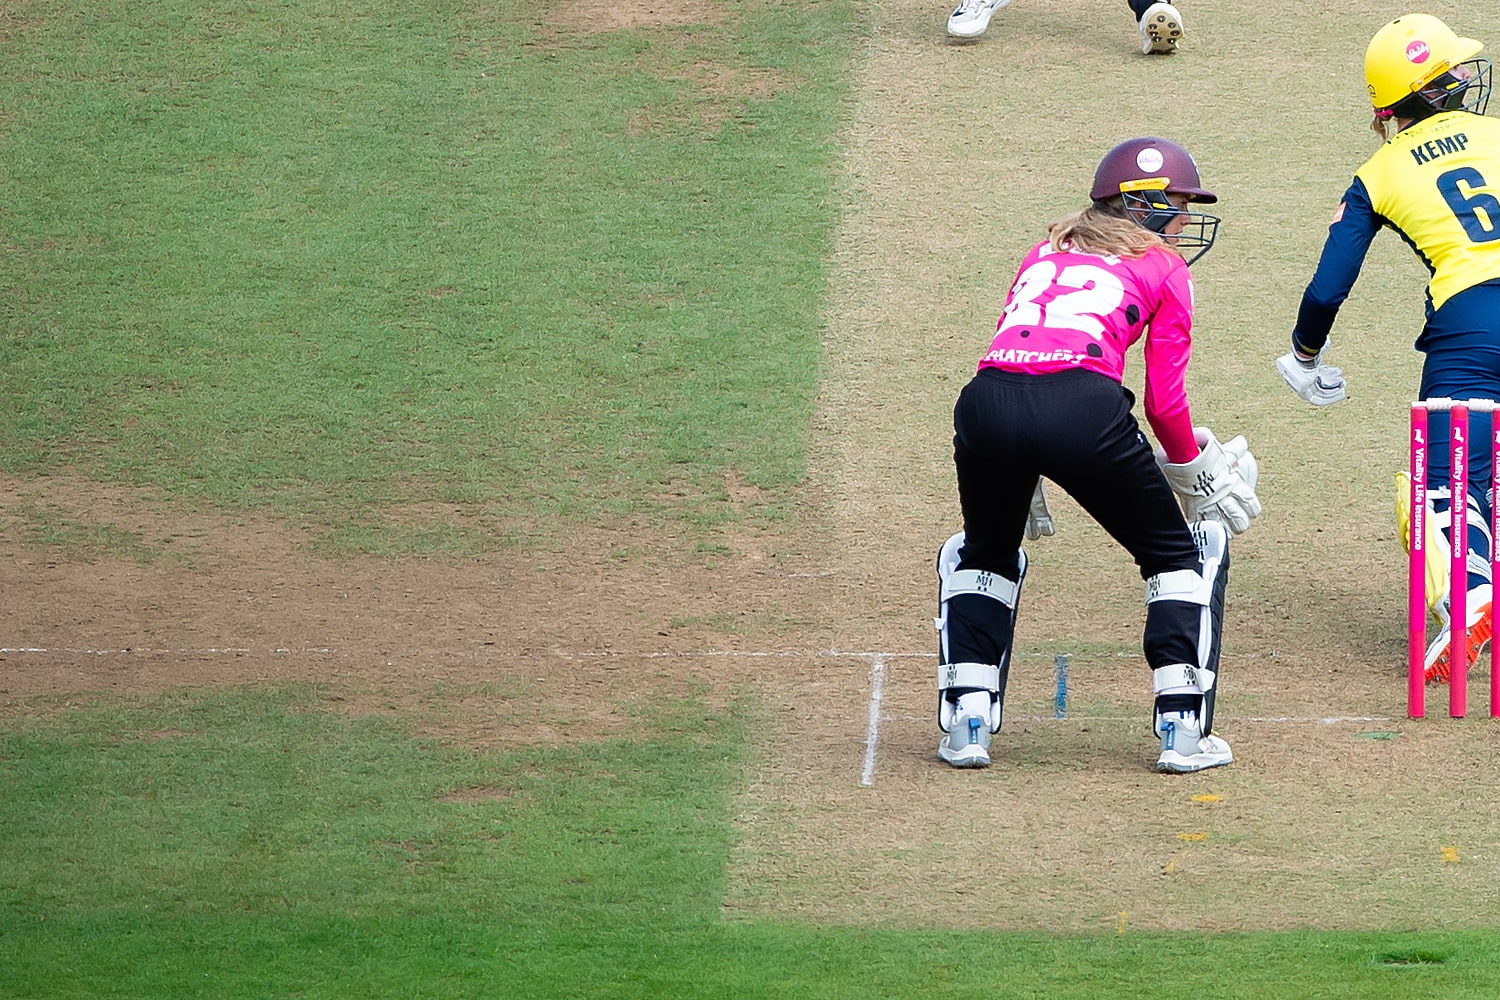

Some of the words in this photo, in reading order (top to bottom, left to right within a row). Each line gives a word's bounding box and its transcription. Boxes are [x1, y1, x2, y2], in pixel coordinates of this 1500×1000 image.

[1410, 133, 1468, 165] KEMP
[1413, 448, 1424, 482] Vitality
[1453, 446, 1463, 480] Vitality
[1414, 485, 1424, 502] Life
[1454, 482, 1463, 512] Health
[1414, 504, 1424, 550] Insurance
[1454, 514, 1463, 558] Insurance
